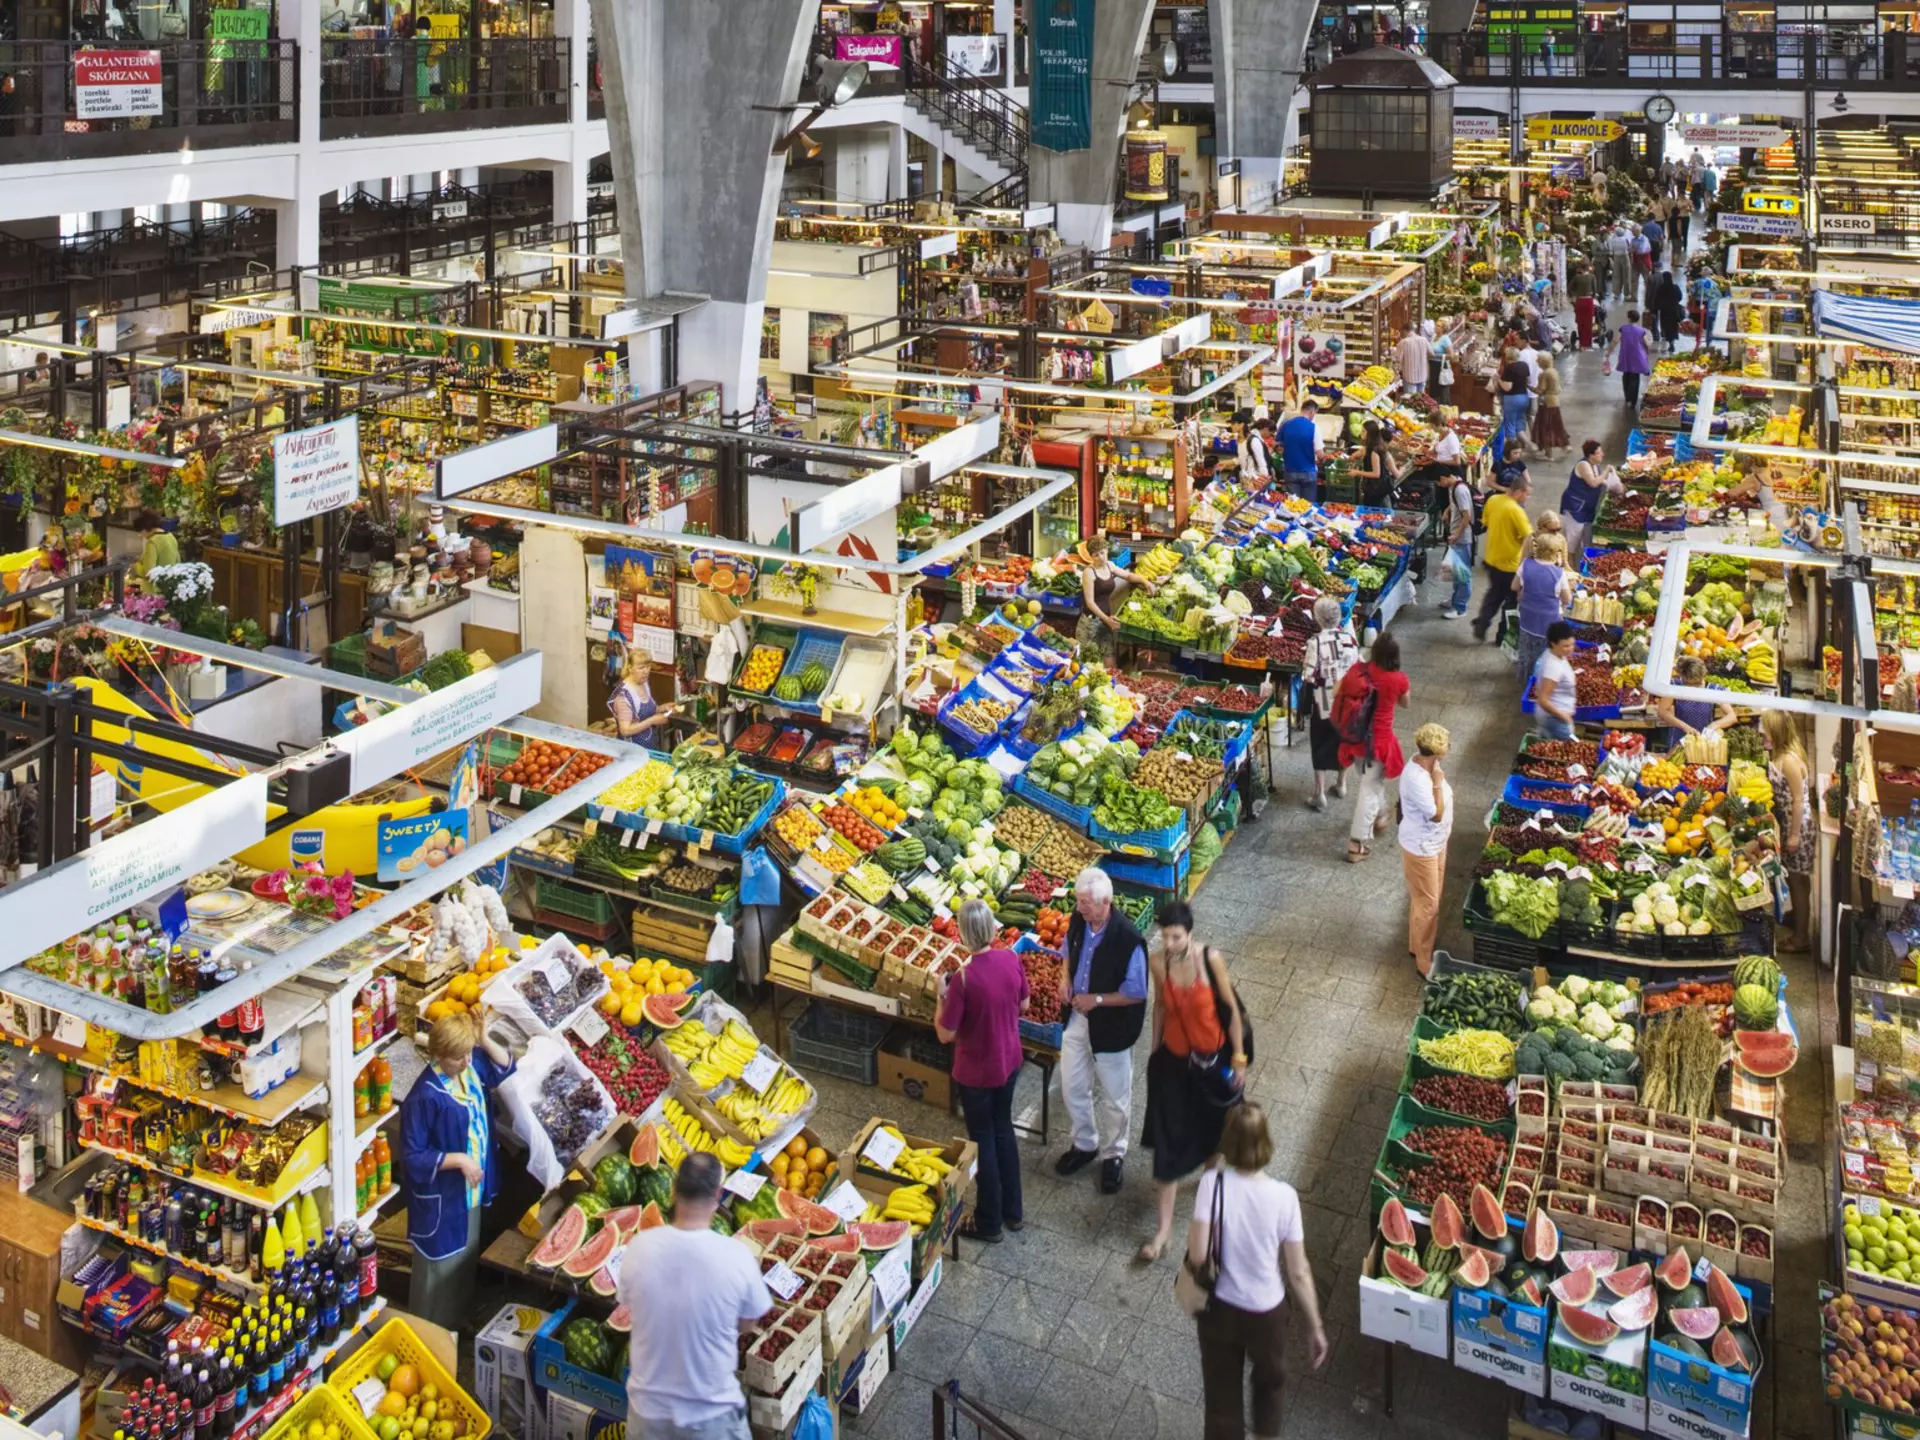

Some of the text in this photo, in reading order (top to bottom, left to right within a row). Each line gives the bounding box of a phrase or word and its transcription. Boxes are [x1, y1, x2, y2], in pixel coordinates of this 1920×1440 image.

[847, 43, 887, 57] Eukanuba
[82, 55, 156, 68] GALANTERIA
[88, 68, 150, 82] SKÓRZANA
[84, 89, 110, 97] torebki
[1551, 123, 1609, 137] ALKOHOLE
[1748, 197, 1795, 210] LOTTO
[1721, 214, 1759, 225] AGENCJA
[1823, 219, 1871, 229] KSERO
[1724, 222, 1756, 232] LOKATY
[383, 818, 442, 841] SWEETY
[294, 835, 321, 845] COBANA
[108, 871, 144, 894] stoisko
[136, 862, 183, 893] ADAMIUK
